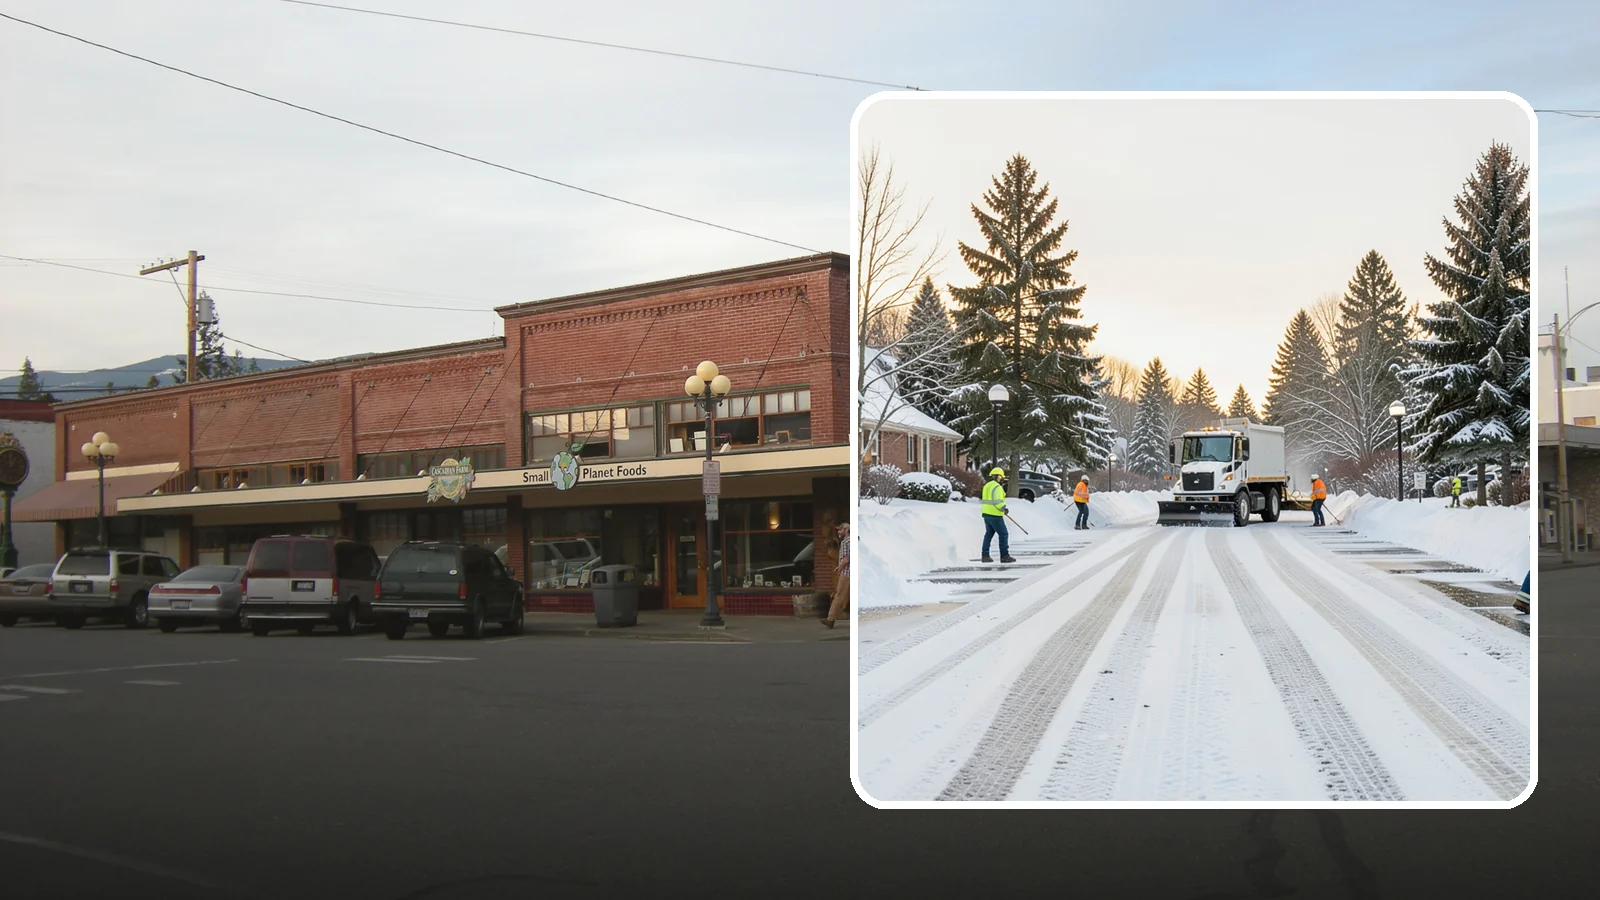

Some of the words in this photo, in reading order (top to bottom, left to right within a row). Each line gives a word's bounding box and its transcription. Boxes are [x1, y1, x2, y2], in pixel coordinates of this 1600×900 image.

[523, 471, 549, 483] Small
[583, 467, 614, 479] Planet
[617, 464, 647, 477] Foods
